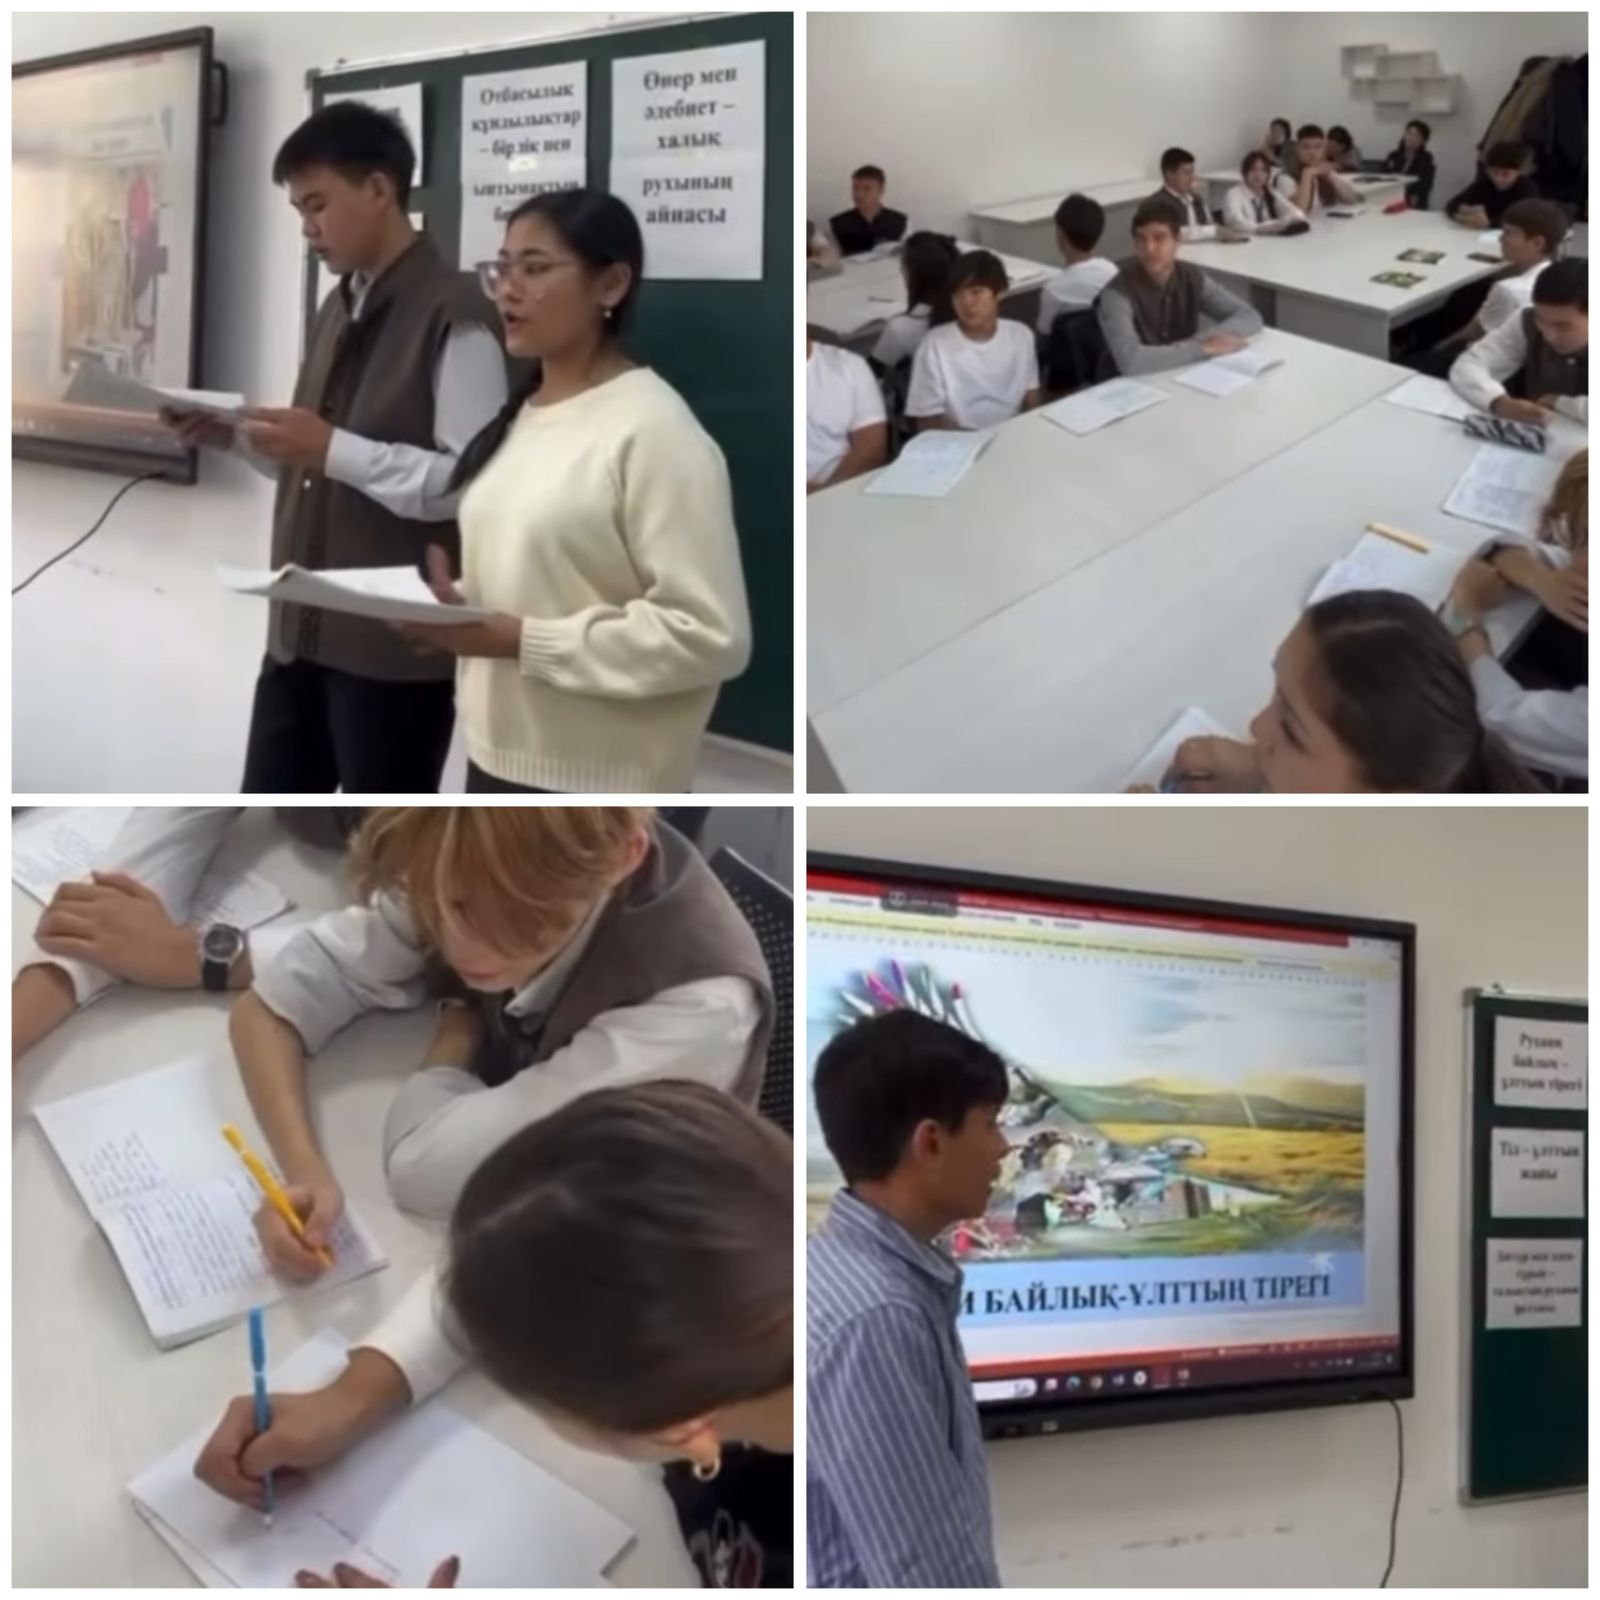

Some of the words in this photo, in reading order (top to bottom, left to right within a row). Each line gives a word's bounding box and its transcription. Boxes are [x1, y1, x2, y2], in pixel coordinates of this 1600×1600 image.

[700, 68, 737, 84] мен
[645, 205, 727, 223] айнасы
[1256, 1274, 1331, 1299] ТІРЕГІ
